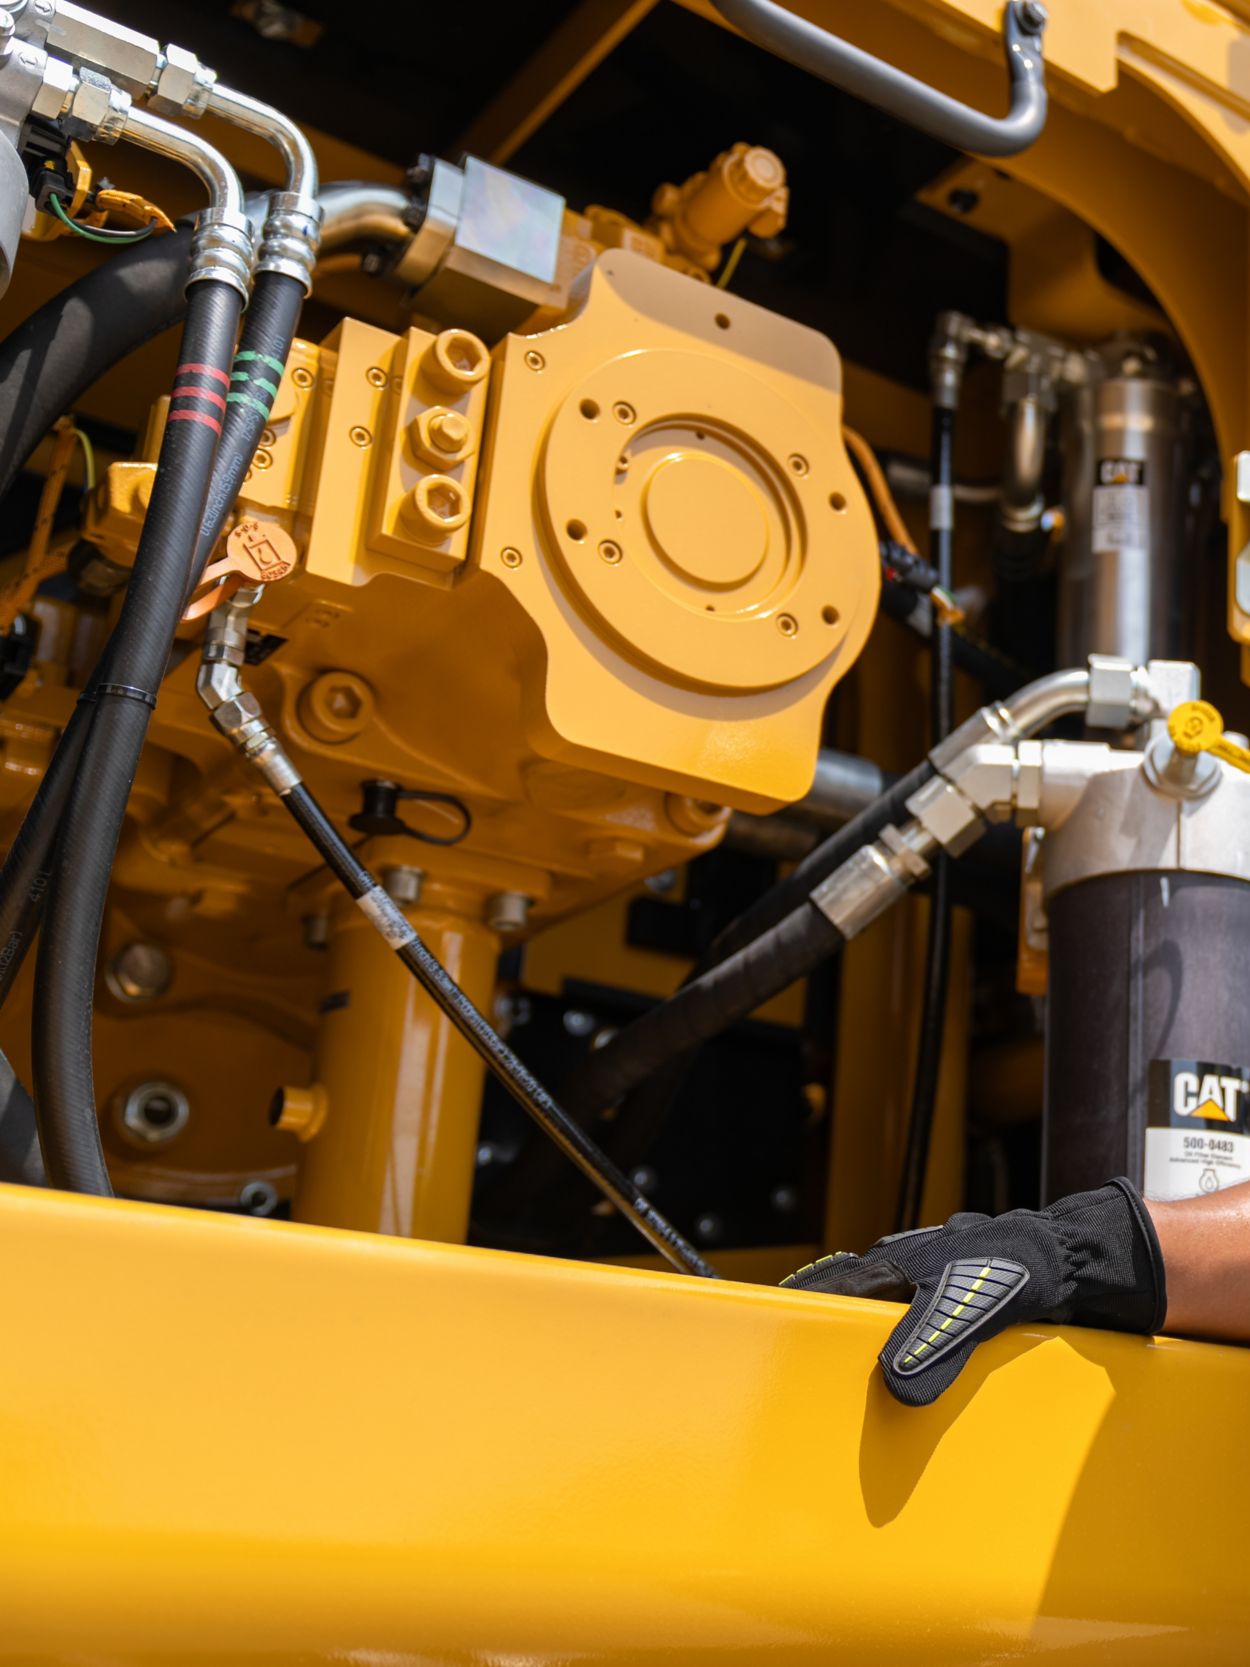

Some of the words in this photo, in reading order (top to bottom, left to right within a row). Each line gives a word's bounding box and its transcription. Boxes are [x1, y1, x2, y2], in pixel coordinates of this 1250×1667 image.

[1100, 460, 1139, 484] CAT
[1174, 1071, 1239, 1123] CAT
[1183, 1136, 1235, 1153] 500-0483
